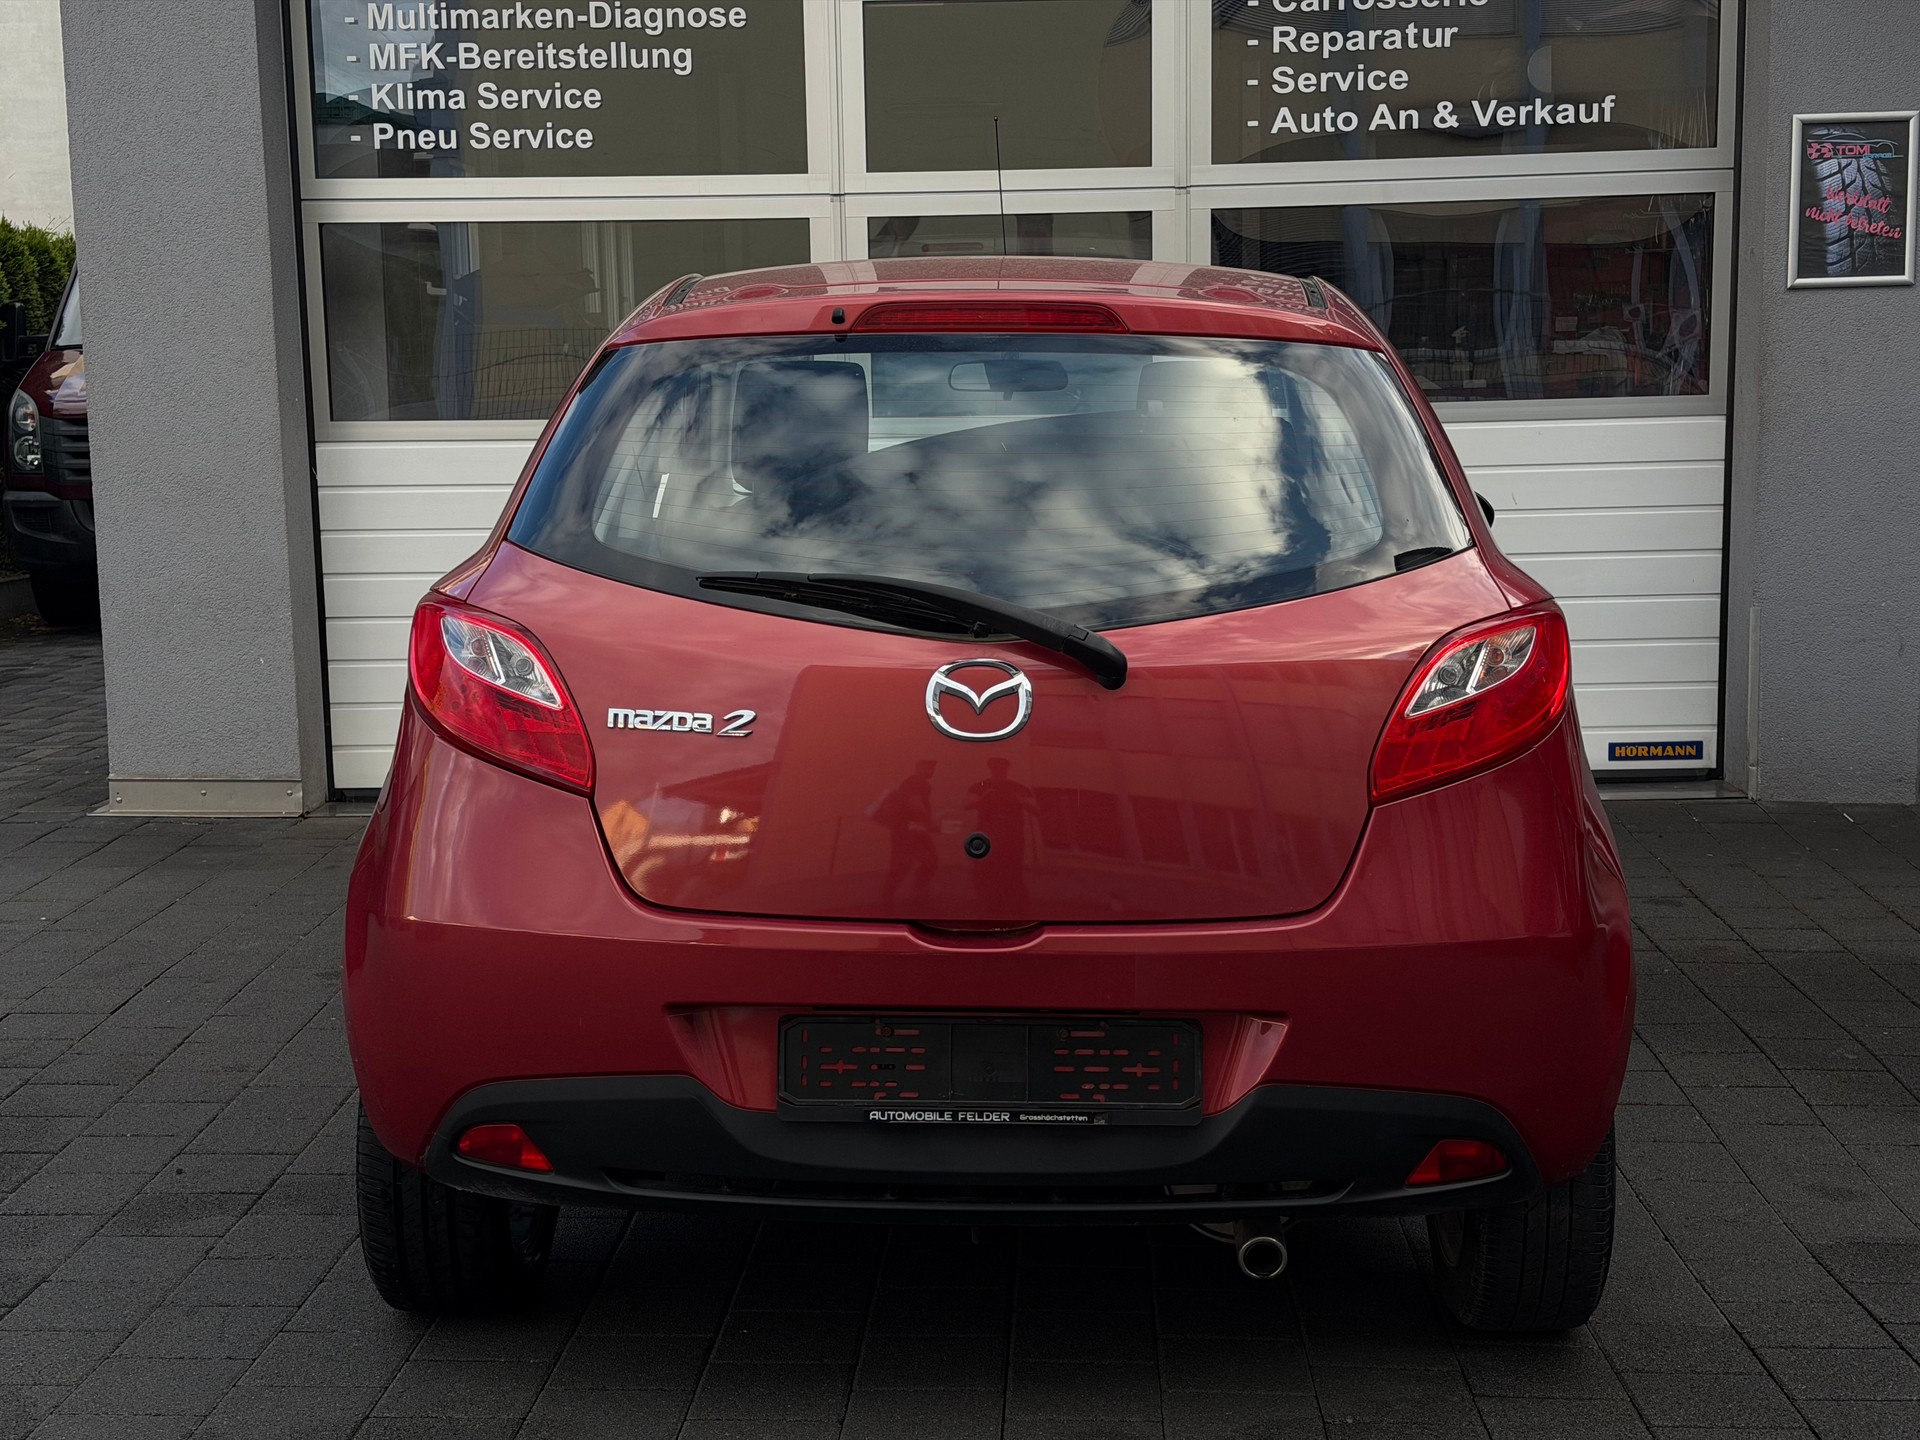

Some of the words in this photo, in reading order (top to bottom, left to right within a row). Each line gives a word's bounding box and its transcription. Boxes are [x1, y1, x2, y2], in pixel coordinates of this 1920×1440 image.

[366, 2, 748, 36] Multimarken-Diagnose
[1272, 22, 1459, 59] Reparatur
[369, 42, 694, 76] MFK-Bereitstellung
[1271, 64, 1410, 94] Service
[371, 83, 467, 110] Klima
[477, 82, 603, 110] Service
[1270, 106, 1359, 134] Auto
[1369, 102, 1420, 131] An
[1433, 100, 1460, 129] &
[1471, 95, 1616, 127] Verkauf
[373, 124, 458, 151] Pneu
[469, 122, 594, 149] Service
[716, 709, 757, 738] 2
[869, 1111, 953, 1121] AUTOMOBILE
[958, 1112, 1011, 1122] FELDER
